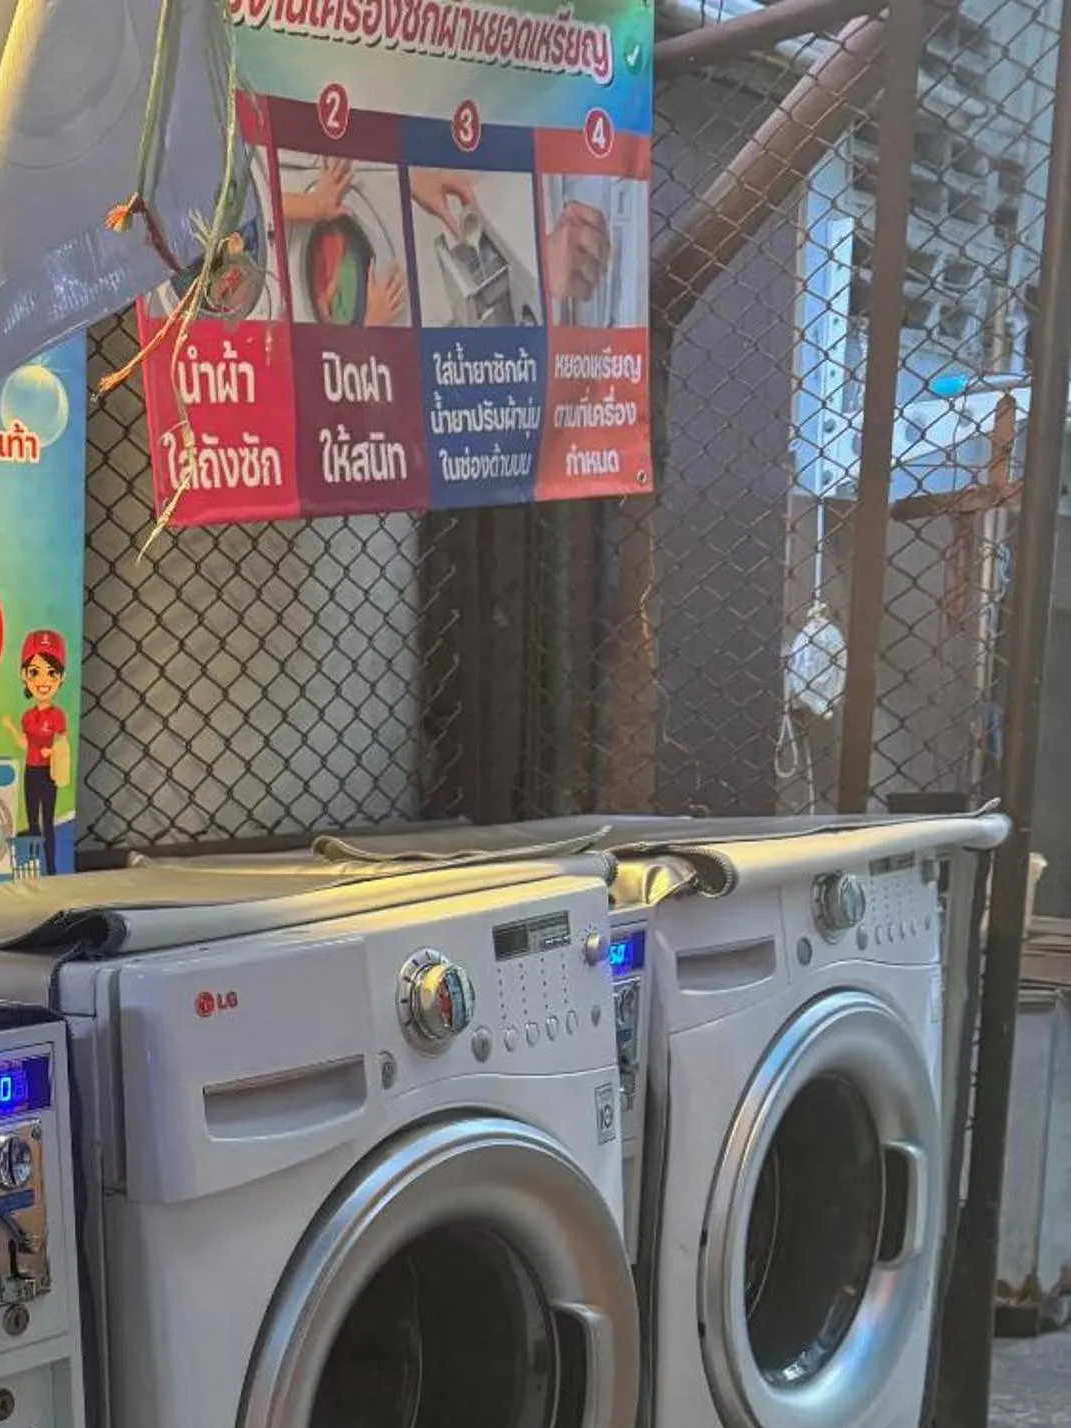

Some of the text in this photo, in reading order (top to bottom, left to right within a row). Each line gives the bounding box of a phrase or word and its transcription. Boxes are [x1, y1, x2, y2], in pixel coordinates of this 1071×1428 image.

[326, 92, 342, 123] 2
[458, 111, 475, 143] 3
[591, 119, 607, 148] 4
[322, 352, 392, 402] ปิดฝา
[217, 990, 238, 1010] LG
